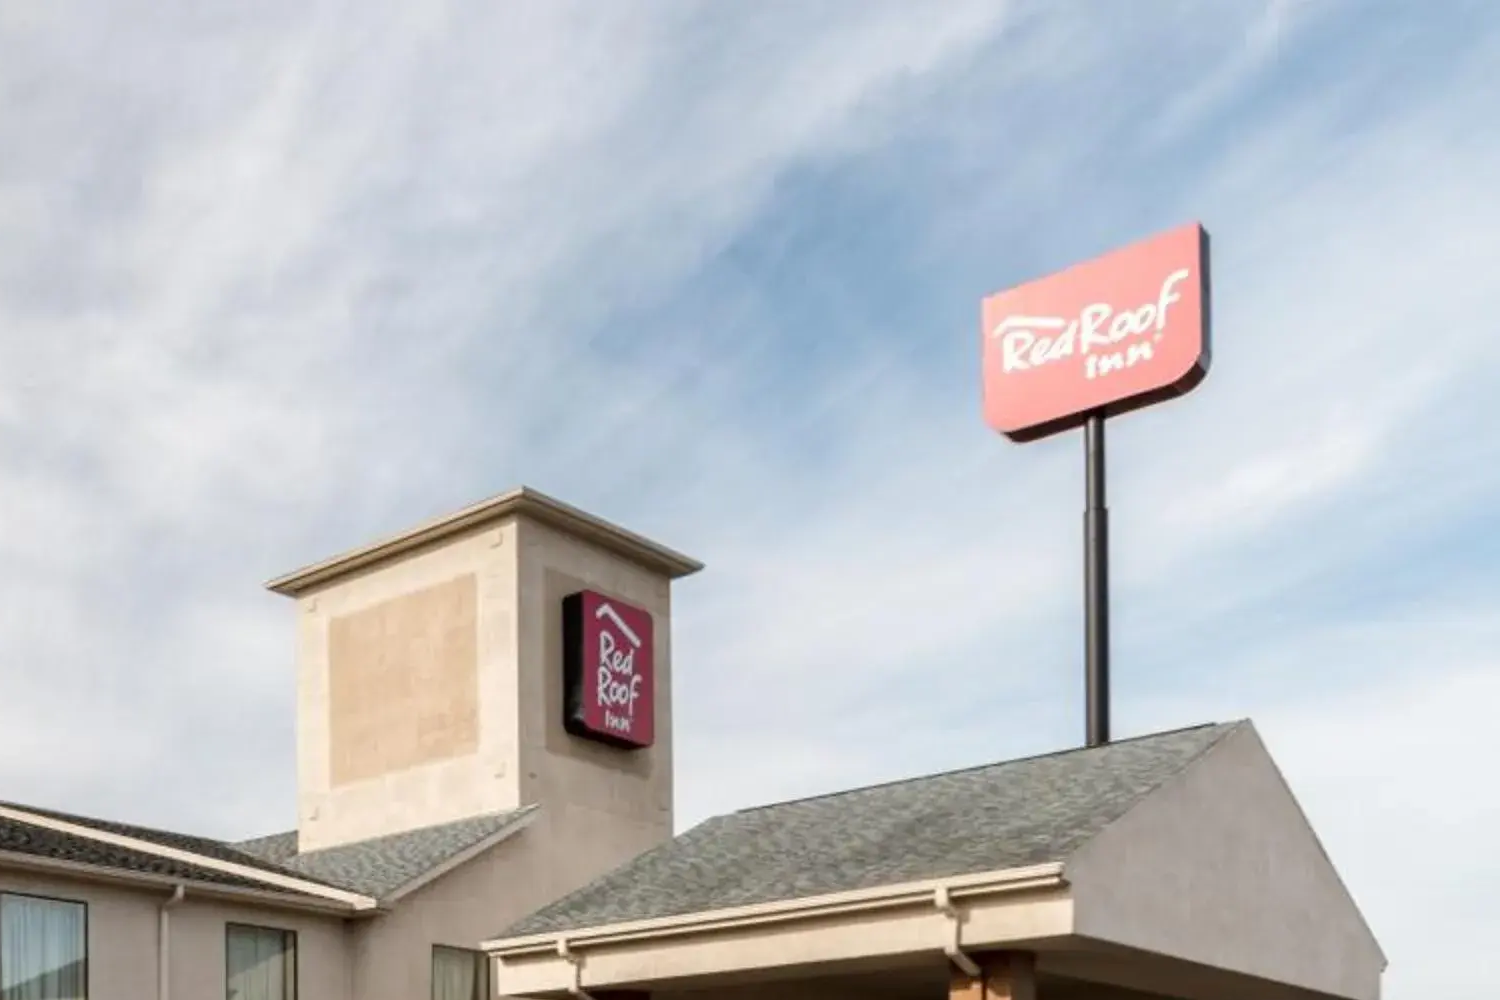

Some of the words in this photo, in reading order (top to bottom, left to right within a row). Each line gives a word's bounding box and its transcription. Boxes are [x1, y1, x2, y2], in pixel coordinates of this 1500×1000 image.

[1002, 320, 1077, 374] Red
[1080, 268, 1189, 354] Roof
[1084, 340, 1155, 380] Inn
[600, 630, 635, 676] Red
[597, 666, 643, 716] Roof
[605, 709, 631, 733] Inn
